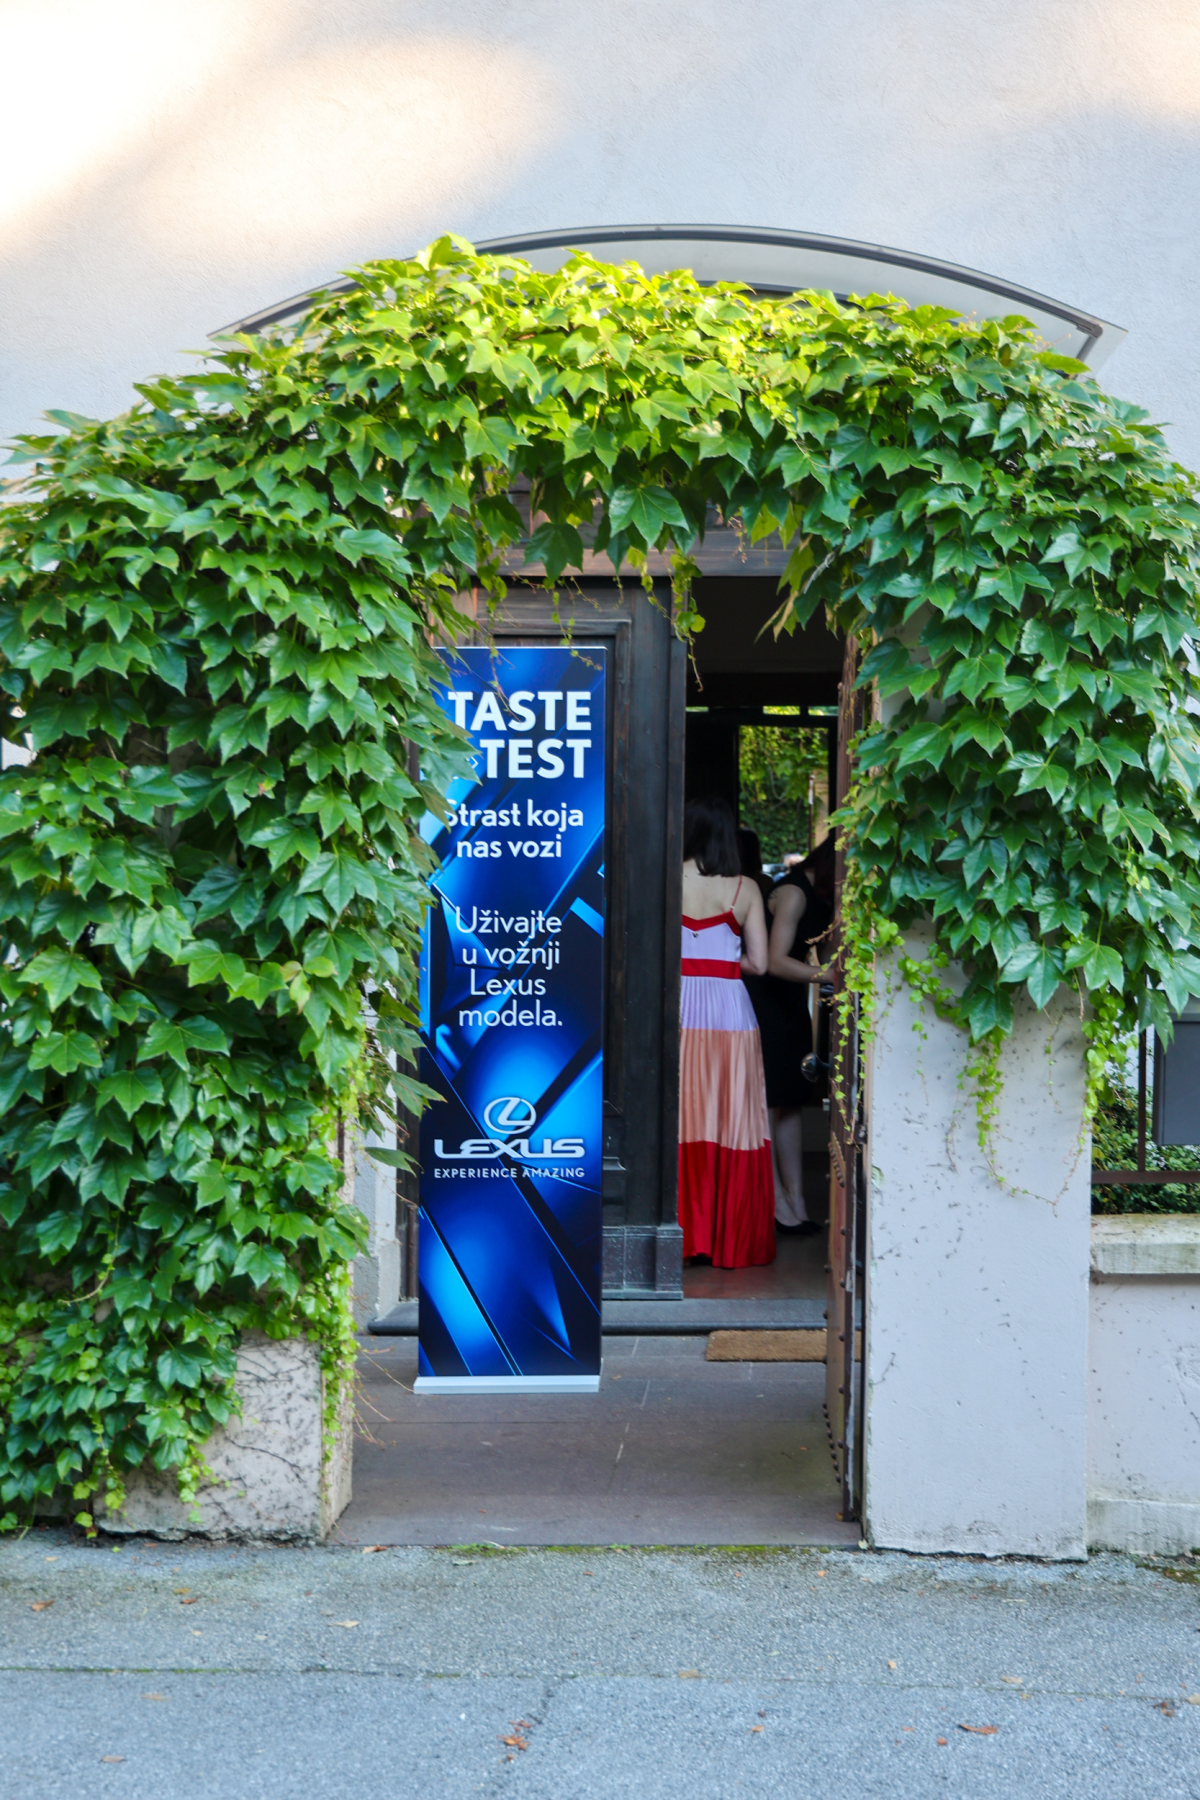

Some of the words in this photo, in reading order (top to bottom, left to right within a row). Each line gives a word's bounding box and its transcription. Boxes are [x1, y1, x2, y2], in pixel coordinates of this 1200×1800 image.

[447, 691, 592, 732] TASTE
[479, 738, 592, 779] TEST
[527, 799, 583, 832] koja
[456, 840, 502, 858] nas
[507, 834, 562, 858] vozi
[455, 906, 562, 939] Uživajte
[462, 948, 477, 965] u
[484, 941, 560, 970] vožnji
[470, 968, 546, 996] Lexus
[458, 999, 563, 1027] modela.
[434, 1138, 586, 1159] LEXUS
[434, 1167, 518, 1179] EXPERIENCE
[522, 1167, 585, 1179] AMAZING
